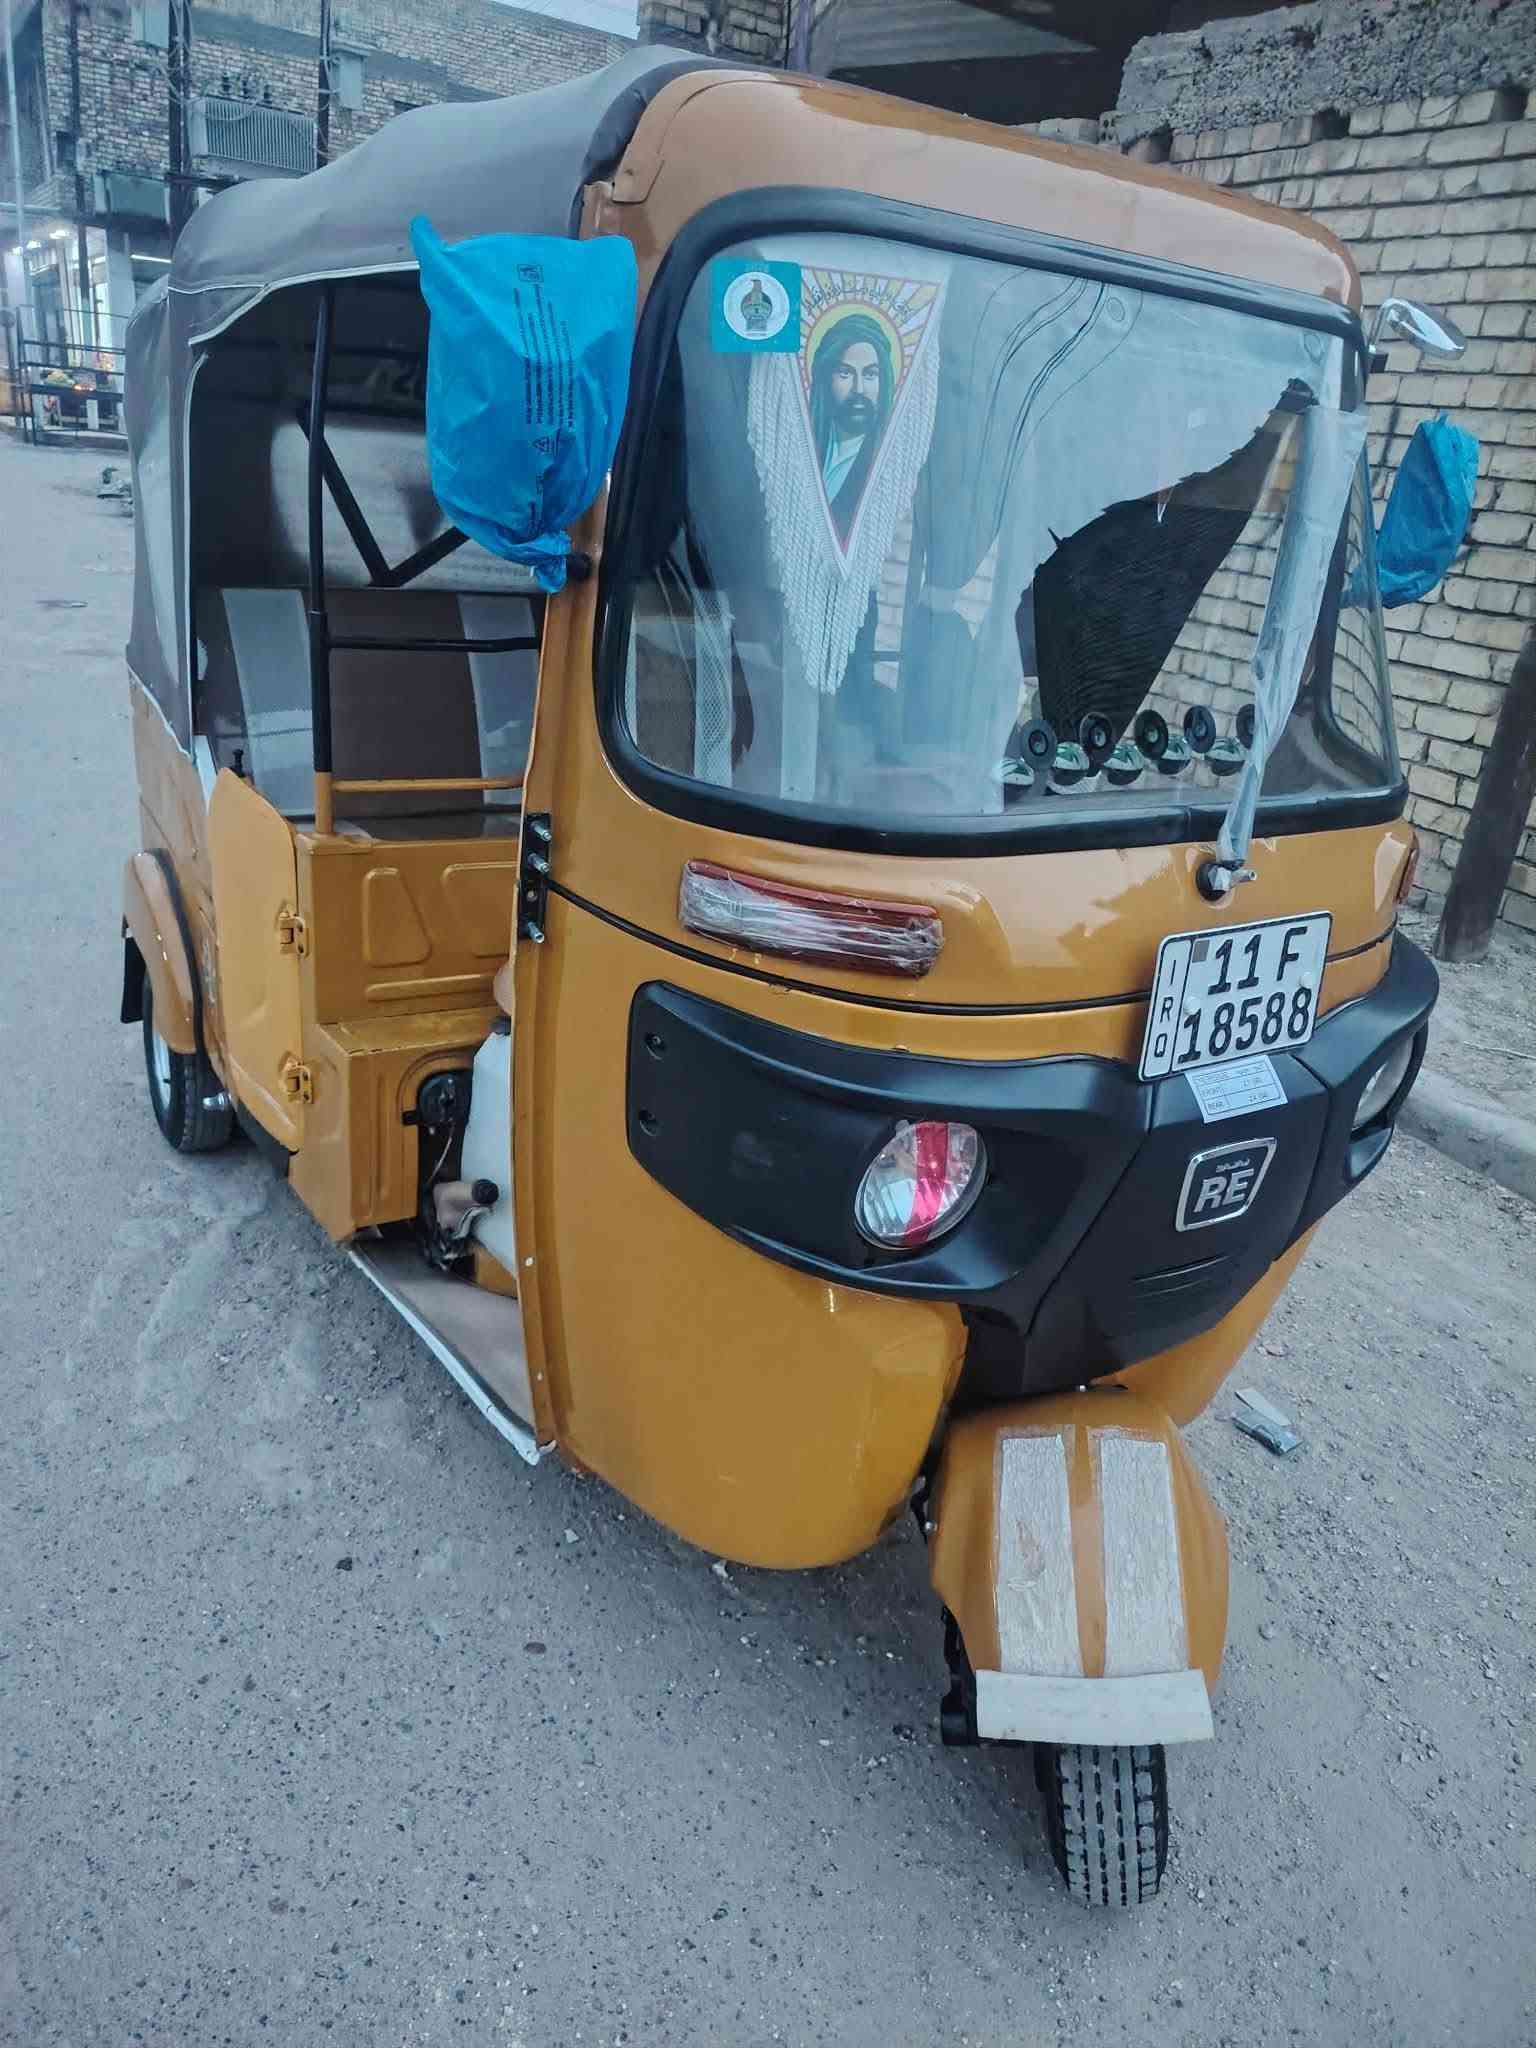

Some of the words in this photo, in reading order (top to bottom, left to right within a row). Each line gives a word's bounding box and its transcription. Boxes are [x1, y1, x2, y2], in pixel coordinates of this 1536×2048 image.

[1208, 934, 1262, 996] 11
[1276, 926, 1308, 982] F
[1178, 986, 1313, 1064] 18588
[1193, 1168, 1255, 1213] RE
